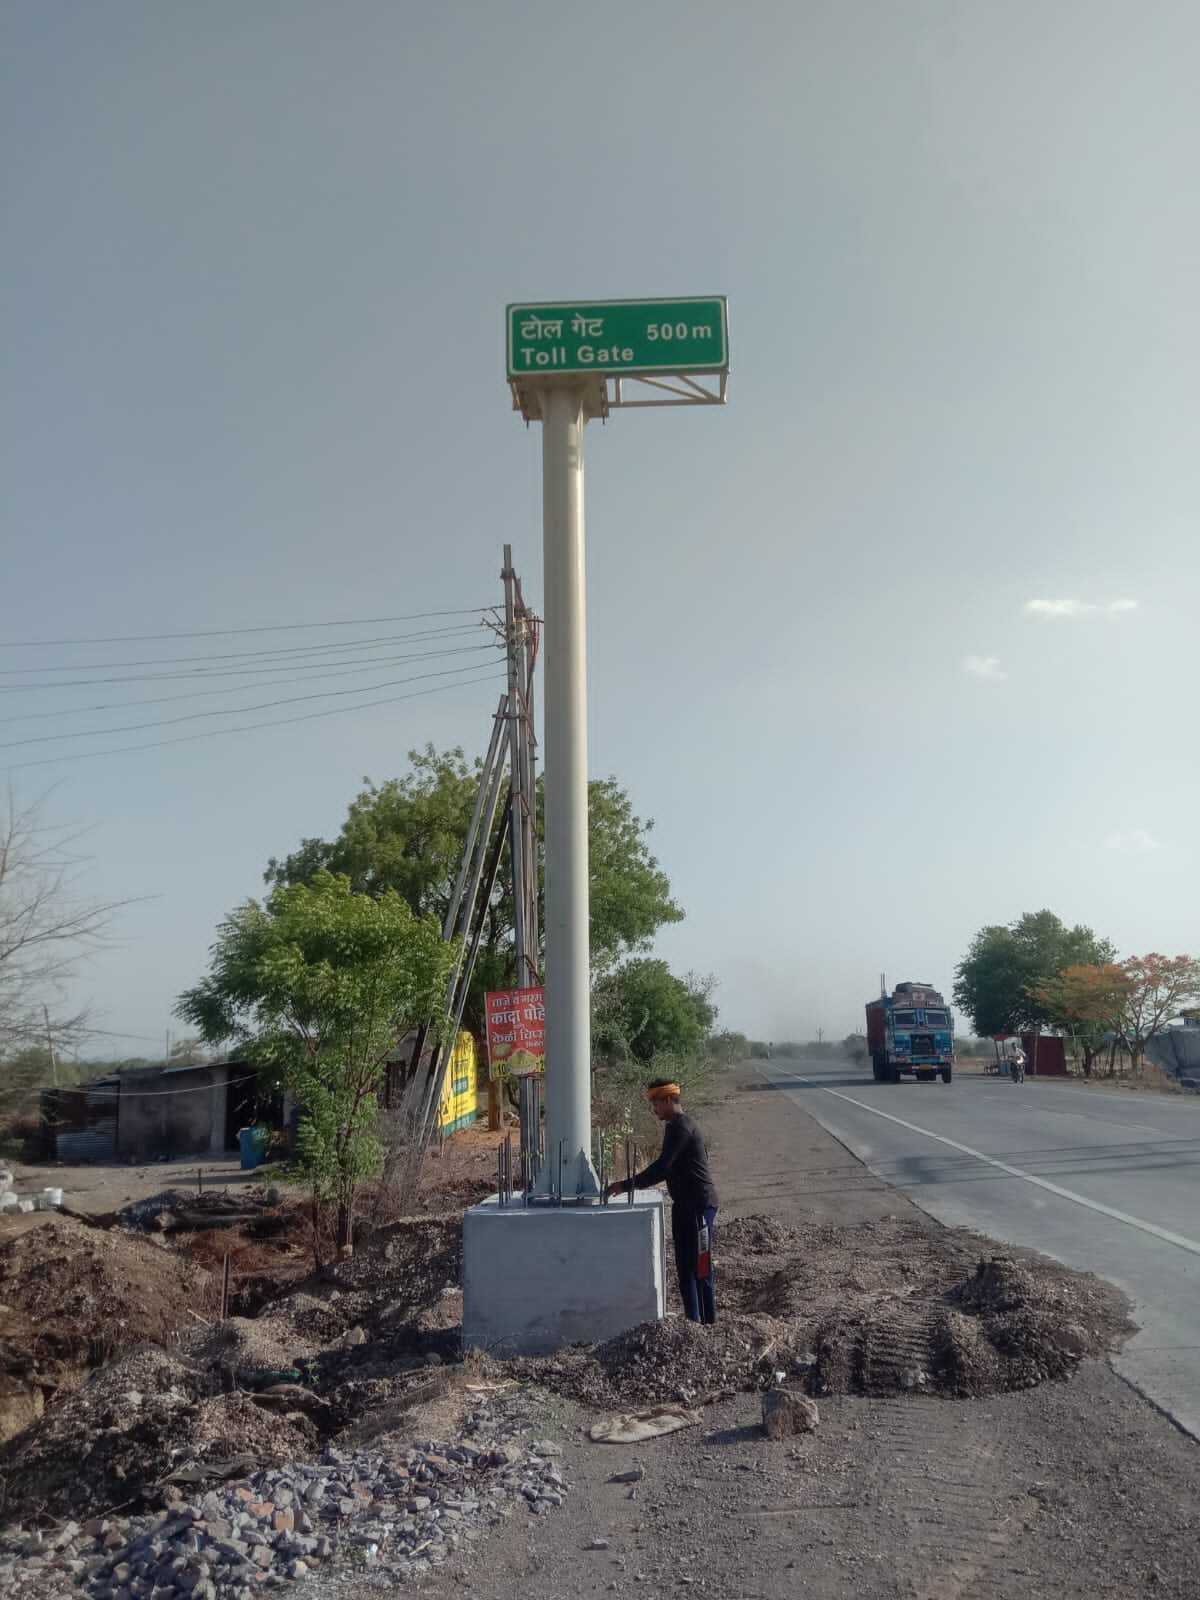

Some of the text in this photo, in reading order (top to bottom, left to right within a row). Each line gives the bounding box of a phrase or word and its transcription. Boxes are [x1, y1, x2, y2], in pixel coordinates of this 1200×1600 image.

[520, 312, 604, 341] टोल गेट
[520, 344, 634, 365] Toll Gate
[491, 1006, 521, 1024] कांदा
